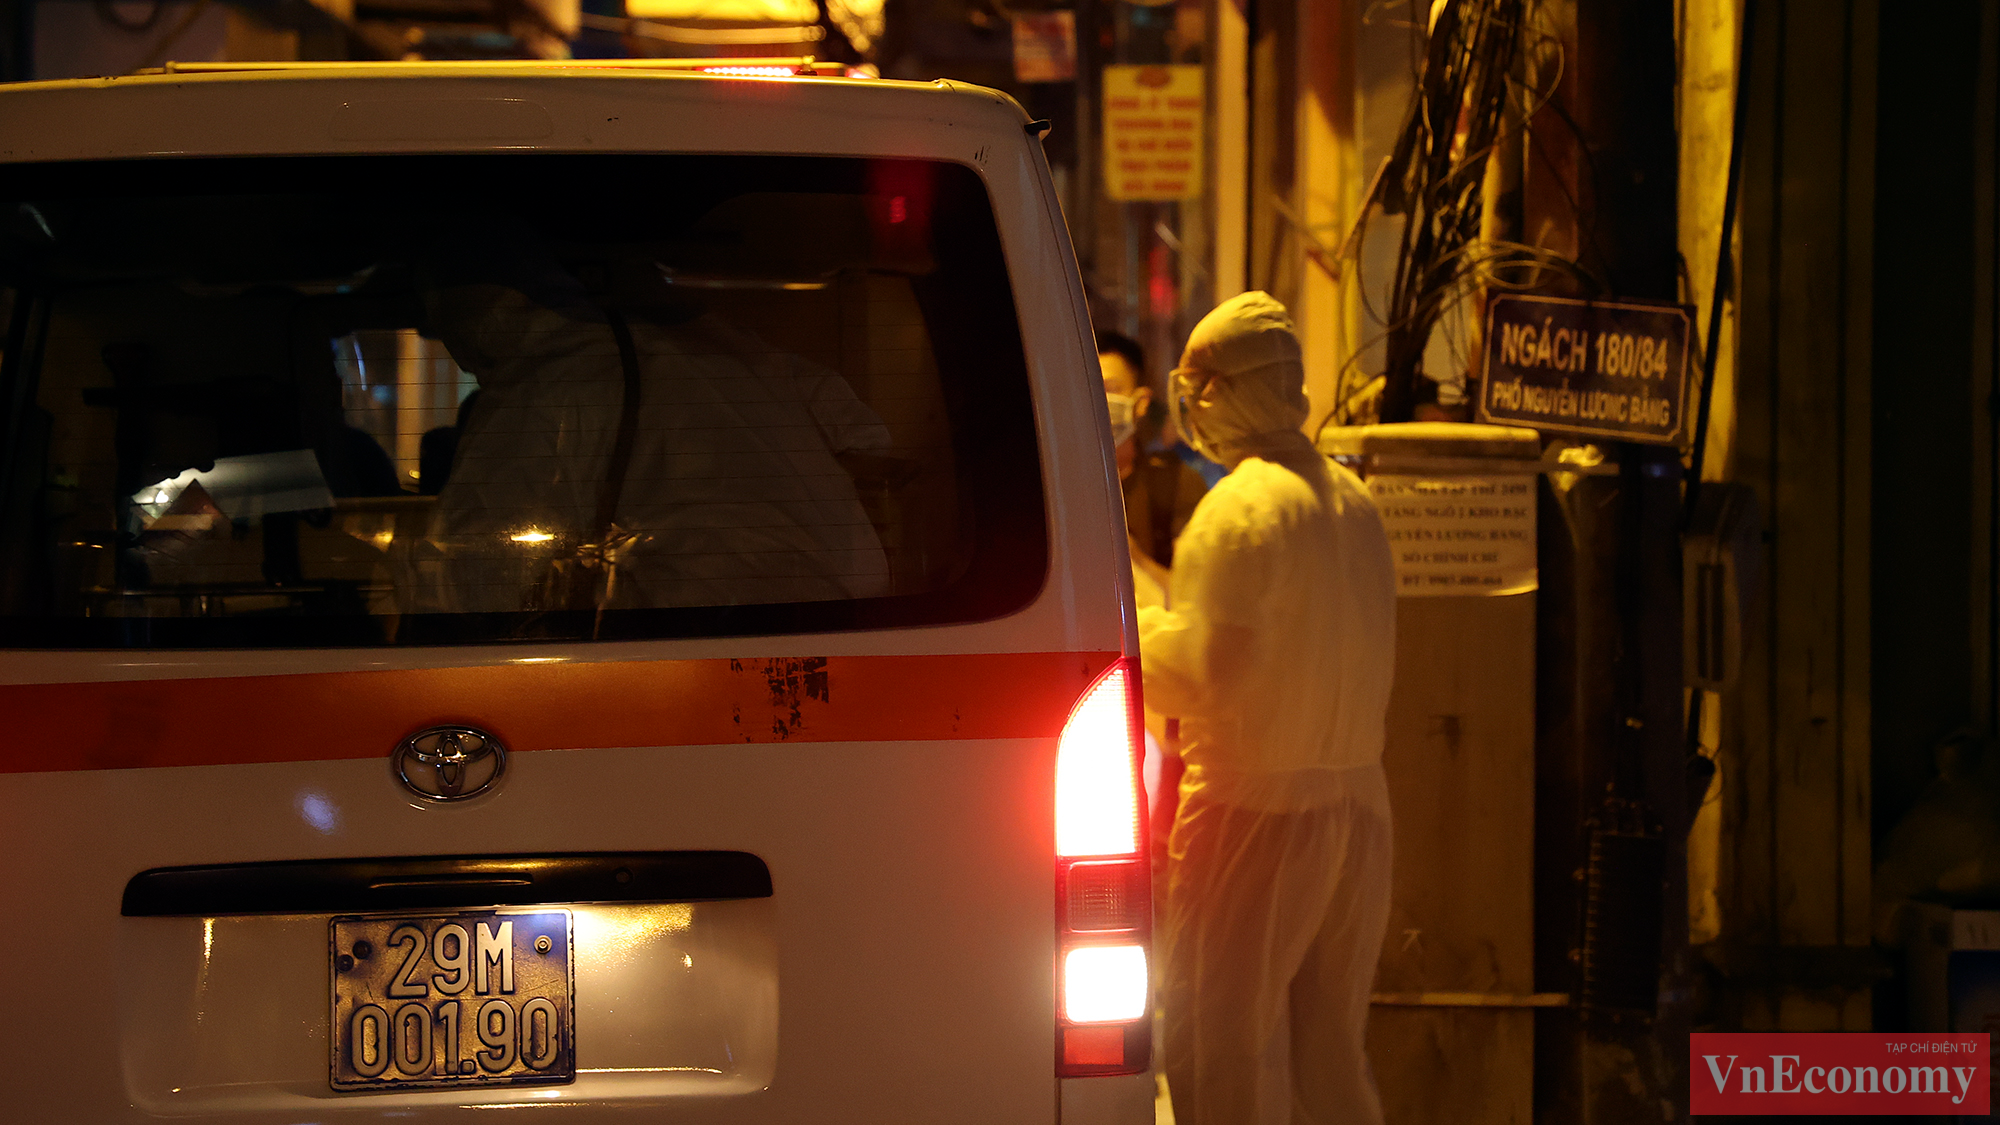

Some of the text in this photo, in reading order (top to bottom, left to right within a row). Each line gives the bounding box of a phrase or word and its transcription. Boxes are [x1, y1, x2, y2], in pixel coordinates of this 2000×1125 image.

[1500, 316, 1669, 381] NGÁCH 180/84
[1492, 376, 1523, 411] PHỐ
[1580, 389, 1628, 423] LƯƠNG
[386, 921, 515, 998] 29M
[351, 997, 559, 1078] 001.90
